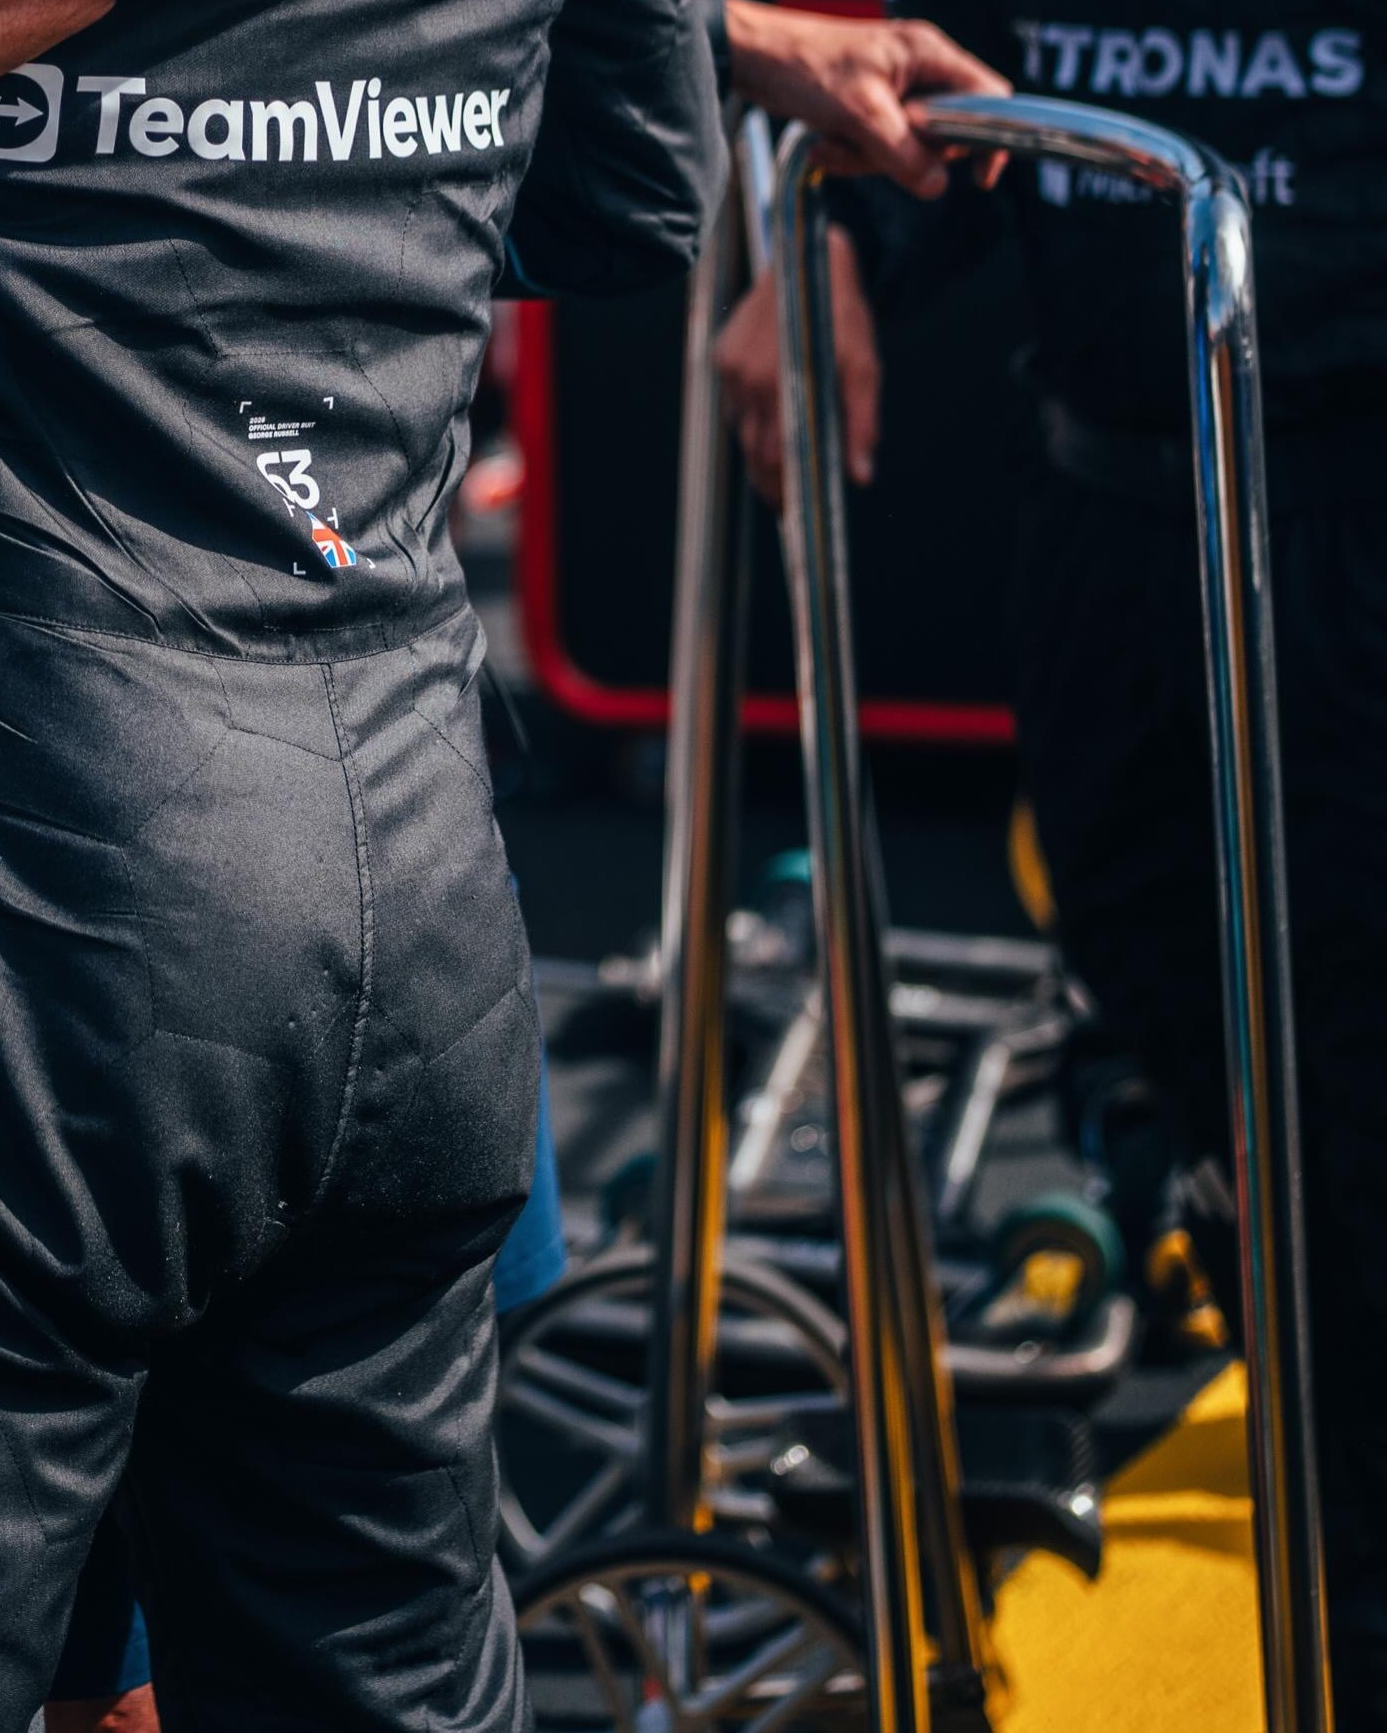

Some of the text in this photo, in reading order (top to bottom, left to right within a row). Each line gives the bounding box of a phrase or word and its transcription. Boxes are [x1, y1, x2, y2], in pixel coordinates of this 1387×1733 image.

[76, 75, 511, 162] TeamViewer
[248, 423, 276, 432] OFFICIAL
[277, 422, 300, 430] DRIVER
